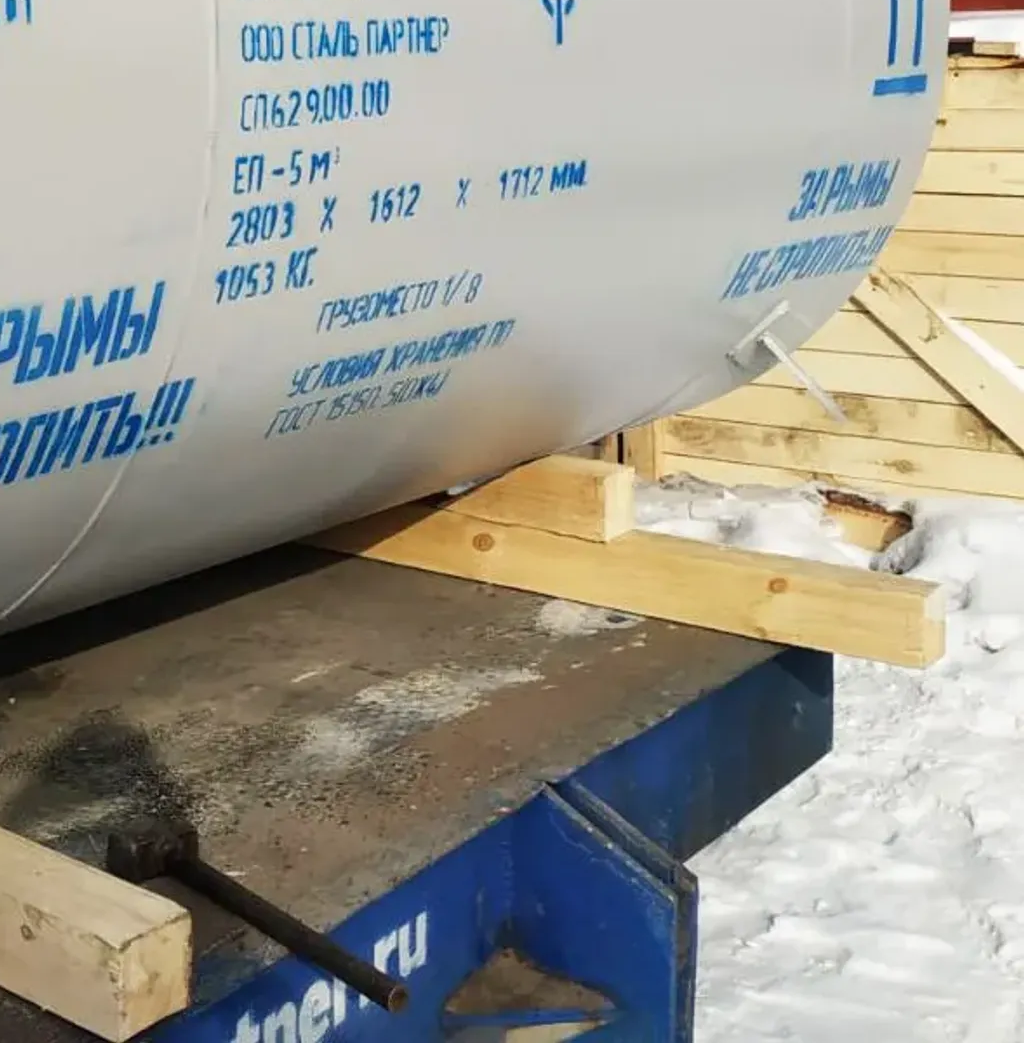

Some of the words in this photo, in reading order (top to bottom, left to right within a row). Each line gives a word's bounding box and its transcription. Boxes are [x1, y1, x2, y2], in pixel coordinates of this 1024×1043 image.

[241, 24, 283, 62] ООО
[292, 20, 359, 60] СТАЛЬ
[366, 15, 449, 56] ПАРТНЕР
[226, 201, 294, 247] 2803
[370, 183, 421, 223] 1612
[499, 167, 544, 200] 1712
[821, 159, 900, 215] РЫМЫ
[216, 261, 275, 304] 1053
[317, 280, 438, 333] ГРУЗОМЕСТО
[287, 348, 386, 397] УСЛОВИЯ
[384, 324, 486, 374] ХРАНЕНИЯ
[264, 397, 326, 439] ГОСТ
